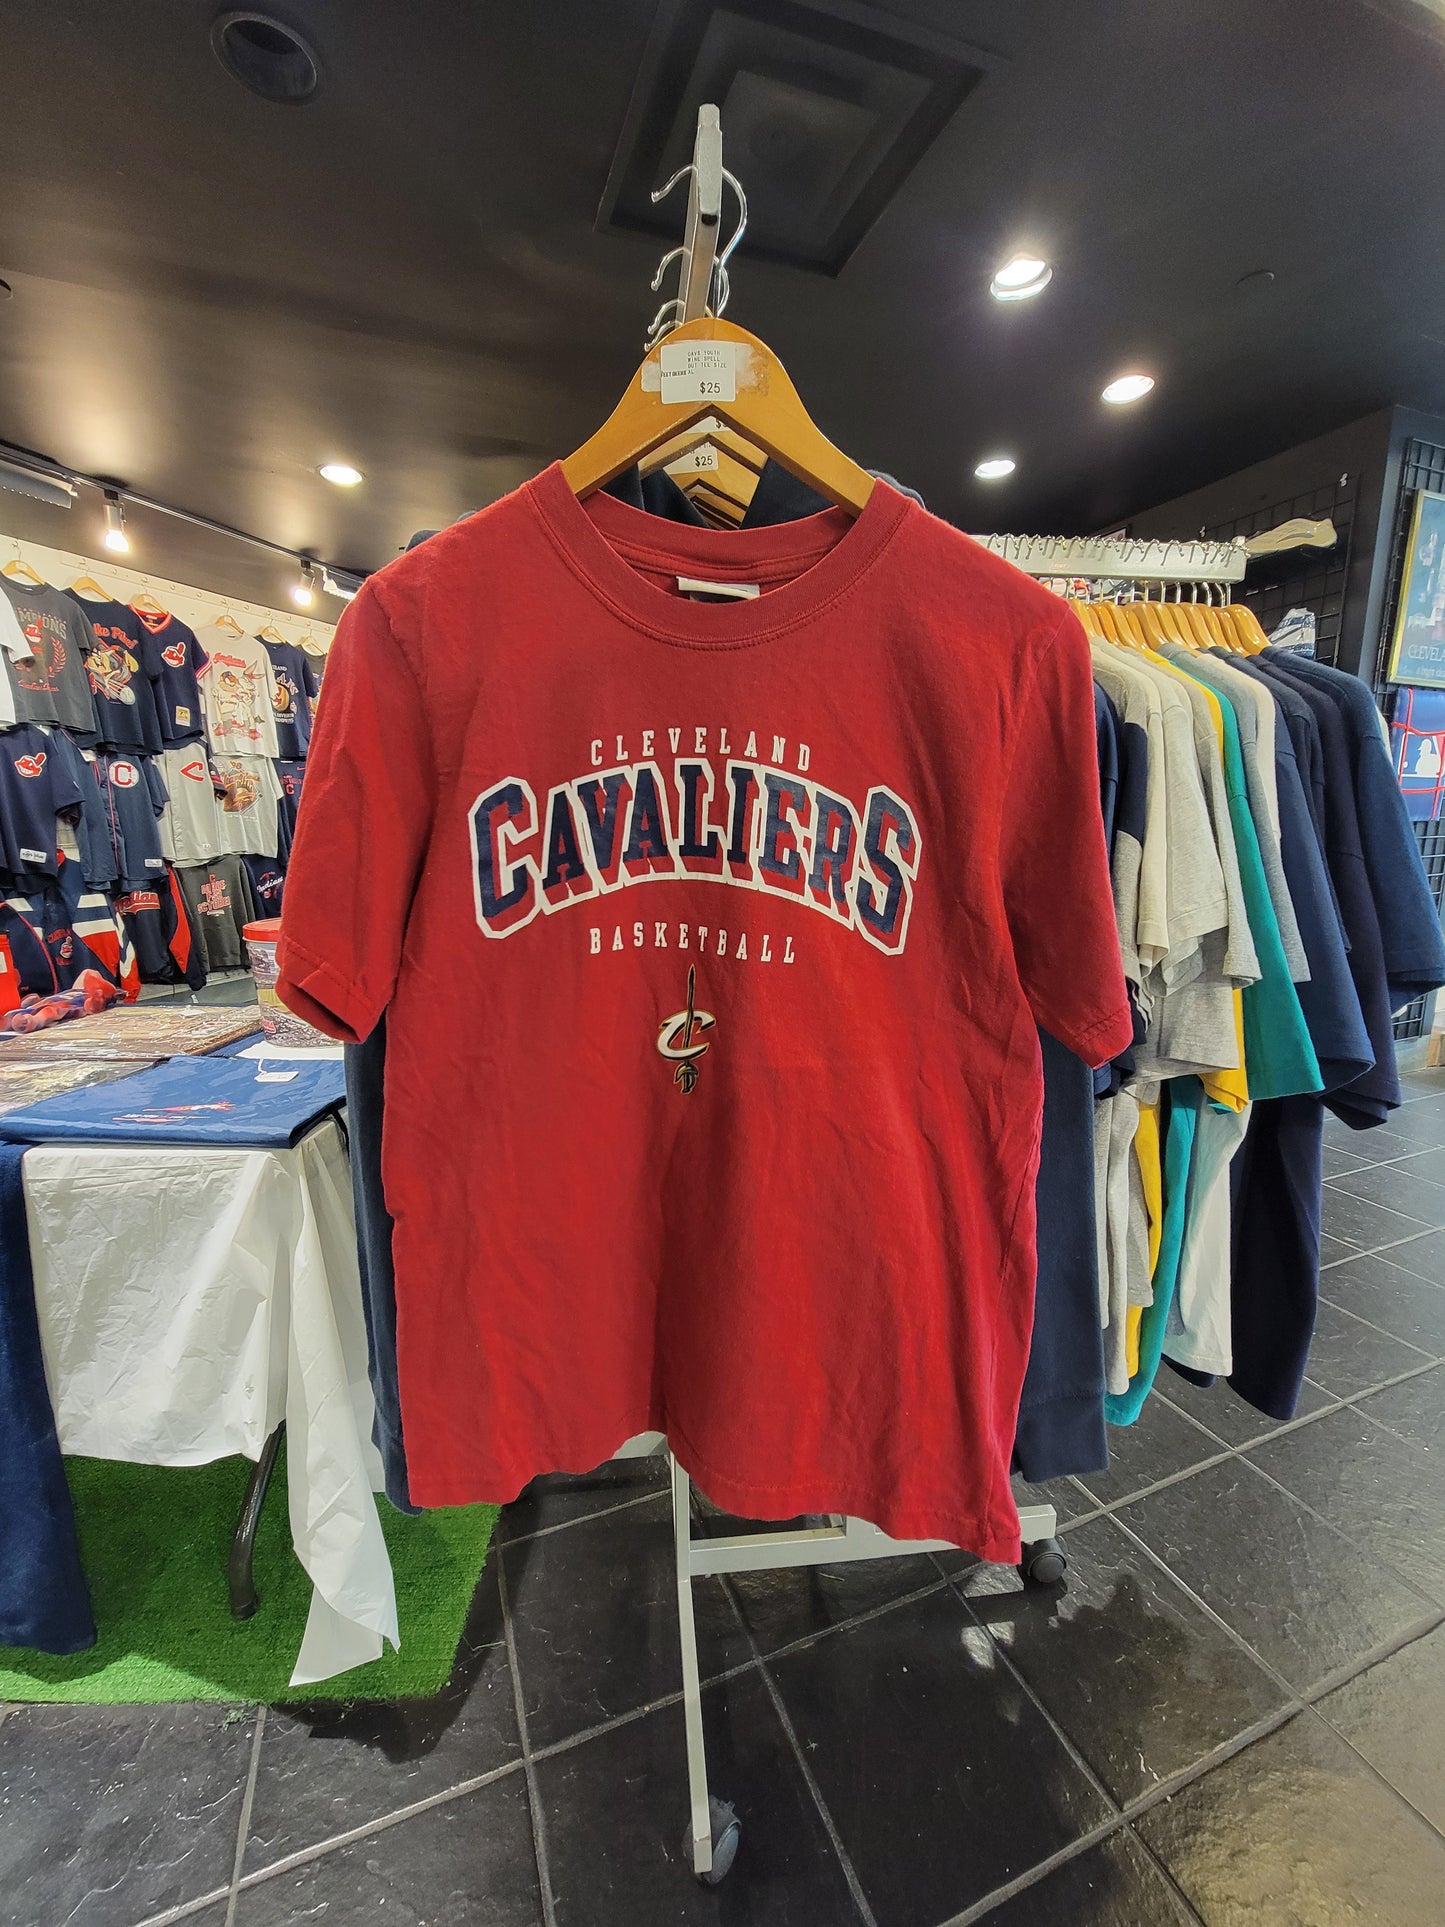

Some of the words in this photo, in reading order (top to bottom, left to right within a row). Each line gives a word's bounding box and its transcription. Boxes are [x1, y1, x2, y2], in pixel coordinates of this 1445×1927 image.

[700, 381, 721, 394] $25
[694, 455, 713, 467] $25
[590, 726, 811, 772] CLEVELAND
[467, 757, 923, 956] CAVALIERS
[589, 921, 796, 964] BASKETBALL
